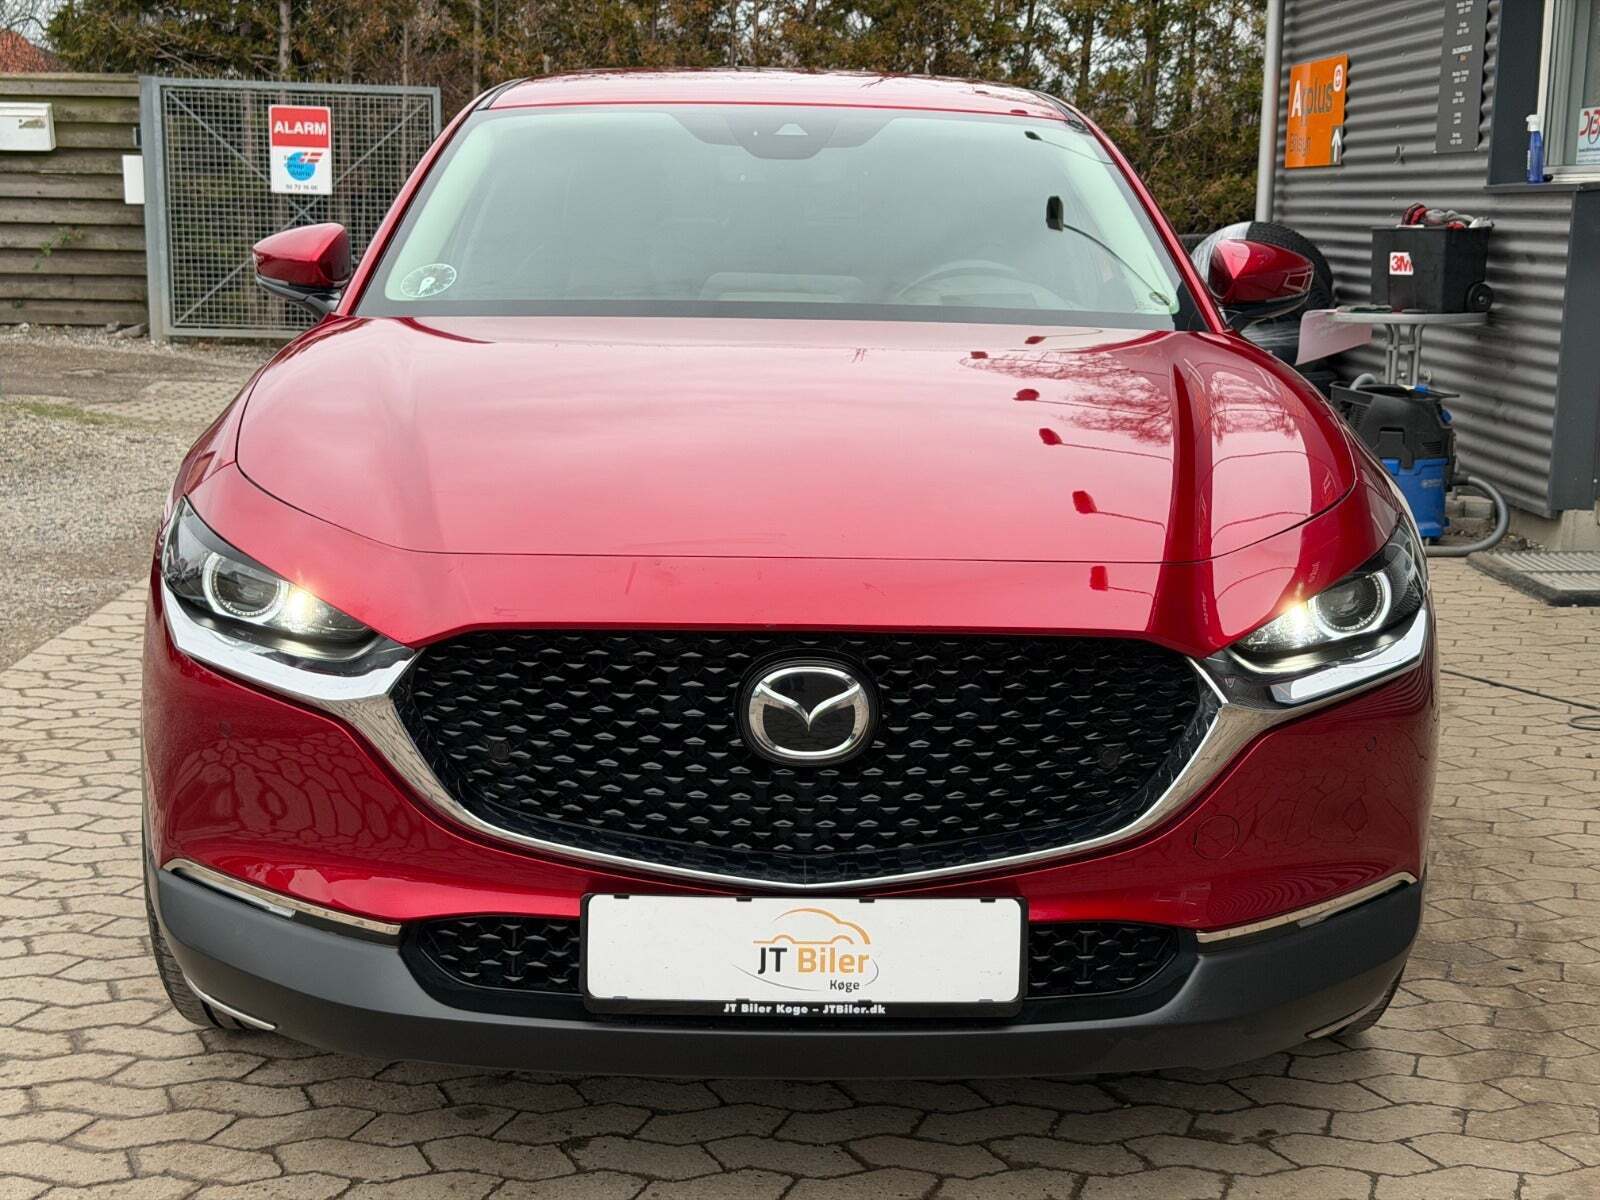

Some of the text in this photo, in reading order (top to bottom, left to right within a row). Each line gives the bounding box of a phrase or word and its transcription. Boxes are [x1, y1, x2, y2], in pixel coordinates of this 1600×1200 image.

[273, 121, 327, 136] ALARM
[1391, 255, 1412, 272] 3M
[758, 947, 870, 975] JT Biler
[829, 979, 860, 993] Køge
[723, 1003, 737, 1013] JT
[741, 1003, 772, 1014] Biler
[823, 1004, 886, 1014] JTBiler.dk
